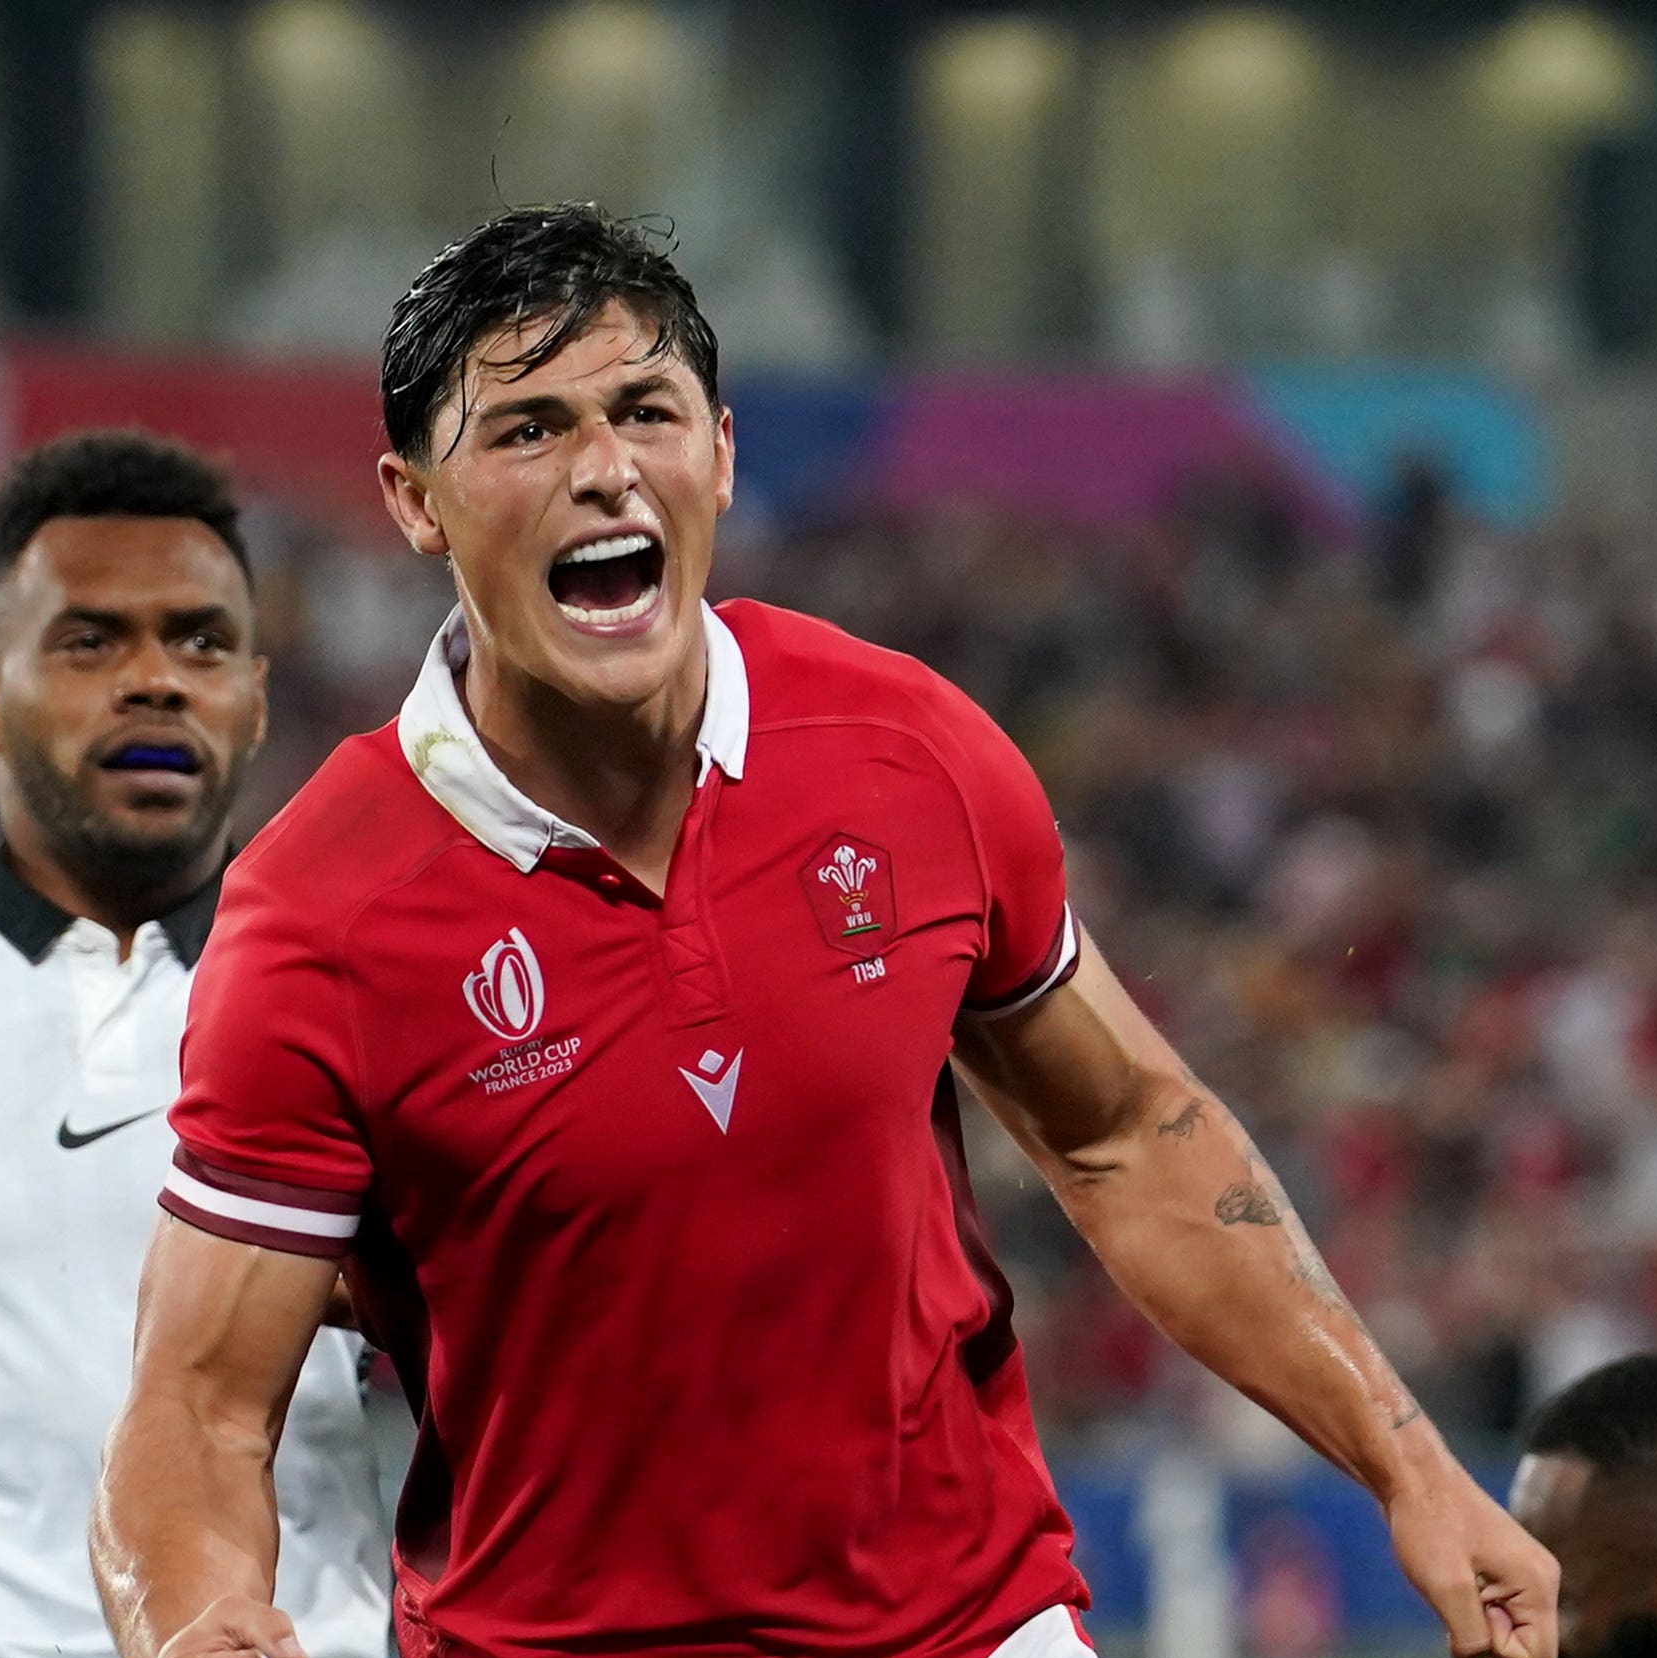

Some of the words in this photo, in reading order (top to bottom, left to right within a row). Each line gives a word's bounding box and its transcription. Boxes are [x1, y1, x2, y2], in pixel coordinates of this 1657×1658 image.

[845, 911, 873, 928] WRU
[851, 957, 886, 984] 1158
[468, 1051, 541, 1083] WORLD
[544, 1037, 581, 1061] CUP
[499, 1038, 544, 1060] RUGBY
[484, 1069, 538, 1095] FRANCE
[537, 1058, 573, 1079] 2023
